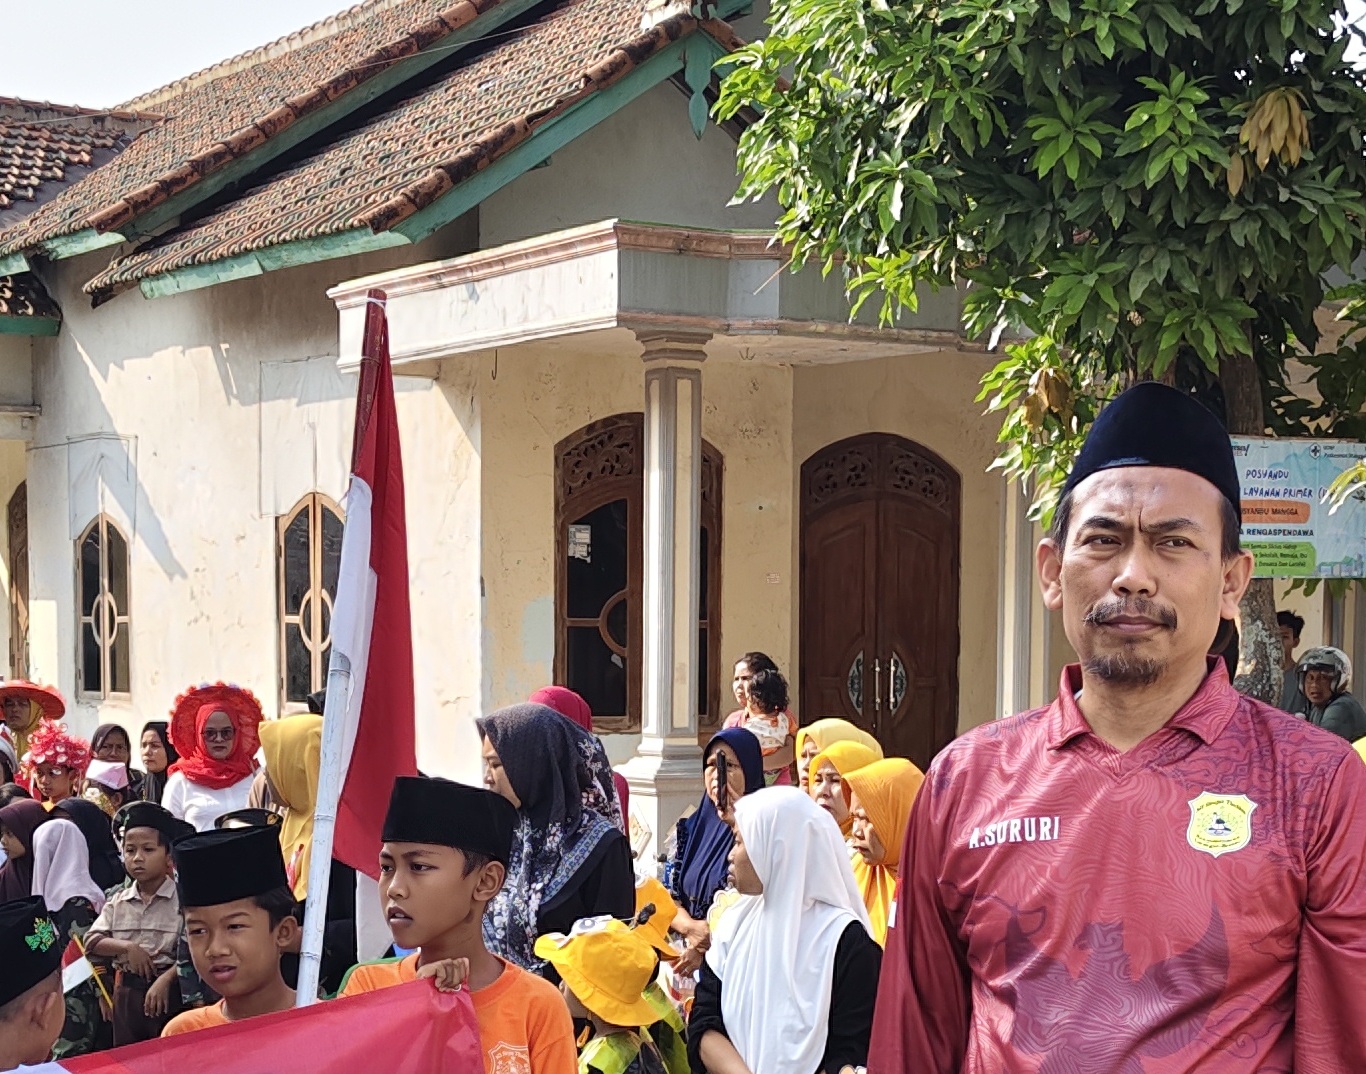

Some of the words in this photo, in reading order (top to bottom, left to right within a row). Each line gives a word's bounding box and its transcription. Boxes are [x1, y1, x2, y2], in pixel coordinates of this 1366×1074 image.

[1246, 469, 1289, 480] POSYANDU
[1243, 487, 1280, 498] LAYANAN
[1283, 488, 1313, 498] PRIMER
[1241, 507, 1270, 516] SYANDU
[968, 816, 1060, 849] A.SURURI
